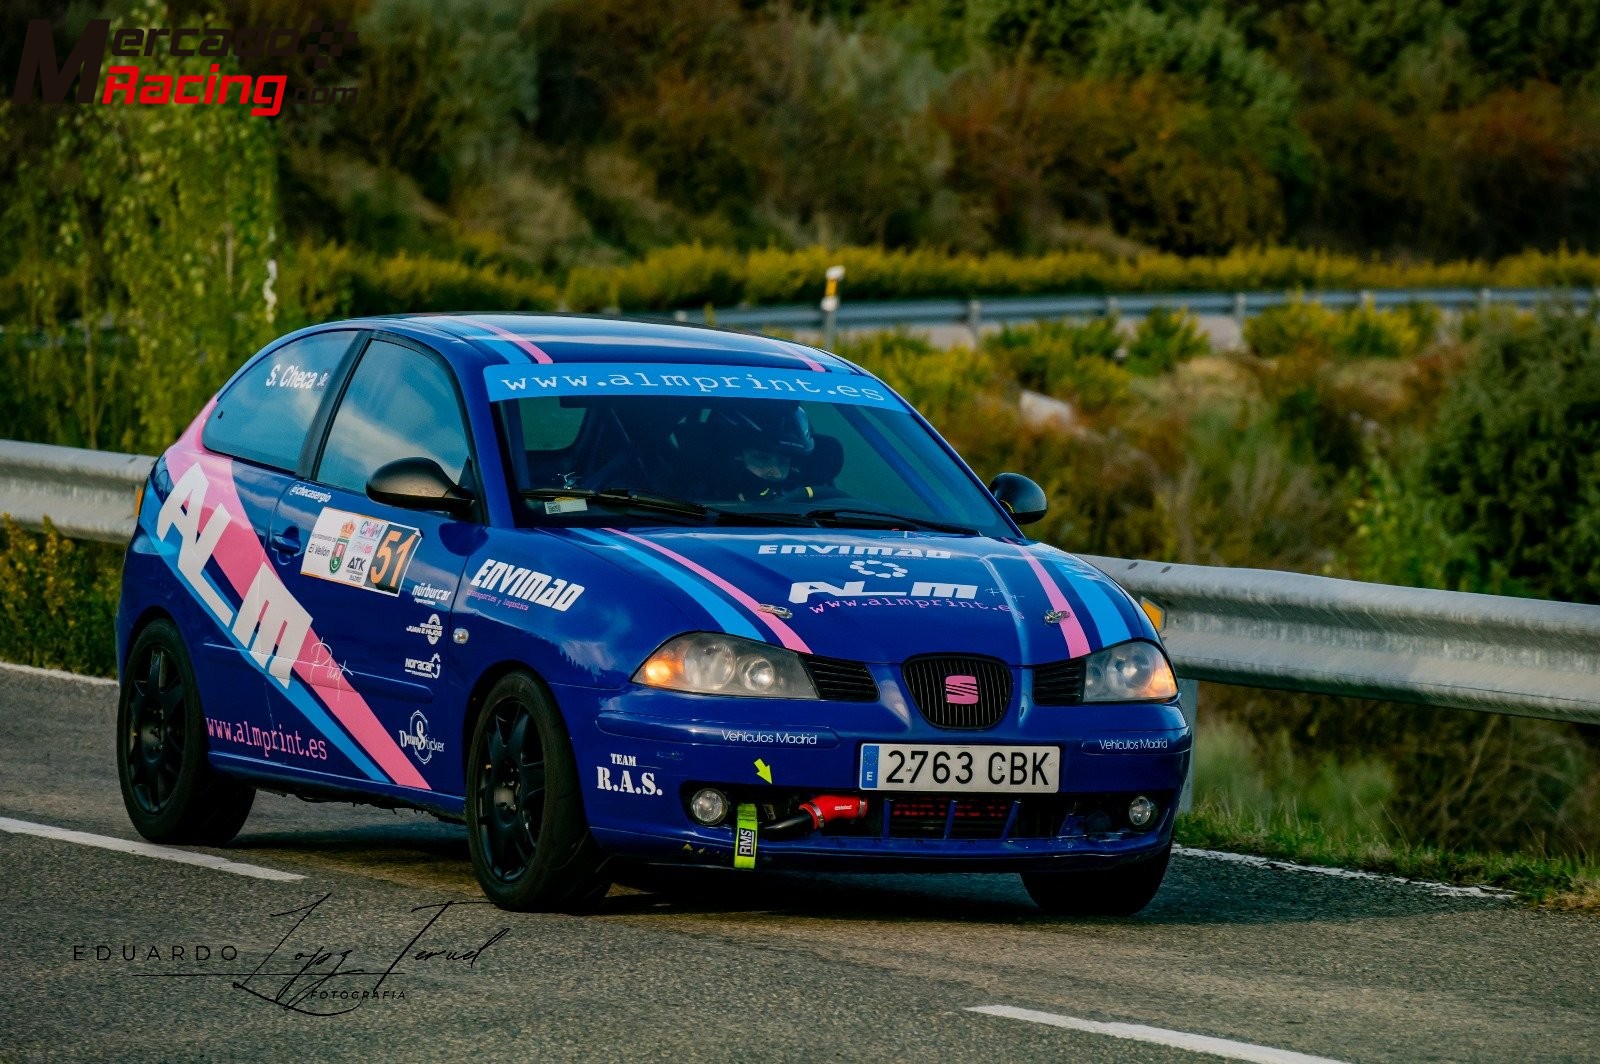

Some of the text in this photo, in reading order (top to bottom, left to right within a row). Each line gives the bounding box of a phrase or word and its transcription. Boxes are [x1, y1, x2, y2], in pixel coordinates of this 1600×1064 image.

[266, 364, 280, 387] S.
[280, 365, 318, 389] Checa
[501, 372, 886, 402] www.almprint.es
[347, 556, 367, 572] ATK
[370, 529, 417, 588] 51
[206, 717, 328, 760] www.almprint.es
[721, 729, 818, 745] Vehículos Madrid
[1139, 738, 1168, 750] Madrid
[610, 753, 637, 767] TEAM
[885, 750, 1051, 786] 2763 CBK
[596, 766, 663, 796] R.A.S.
[866, 771, 874, 782] E
[739, 828, 754, 856] RMS
